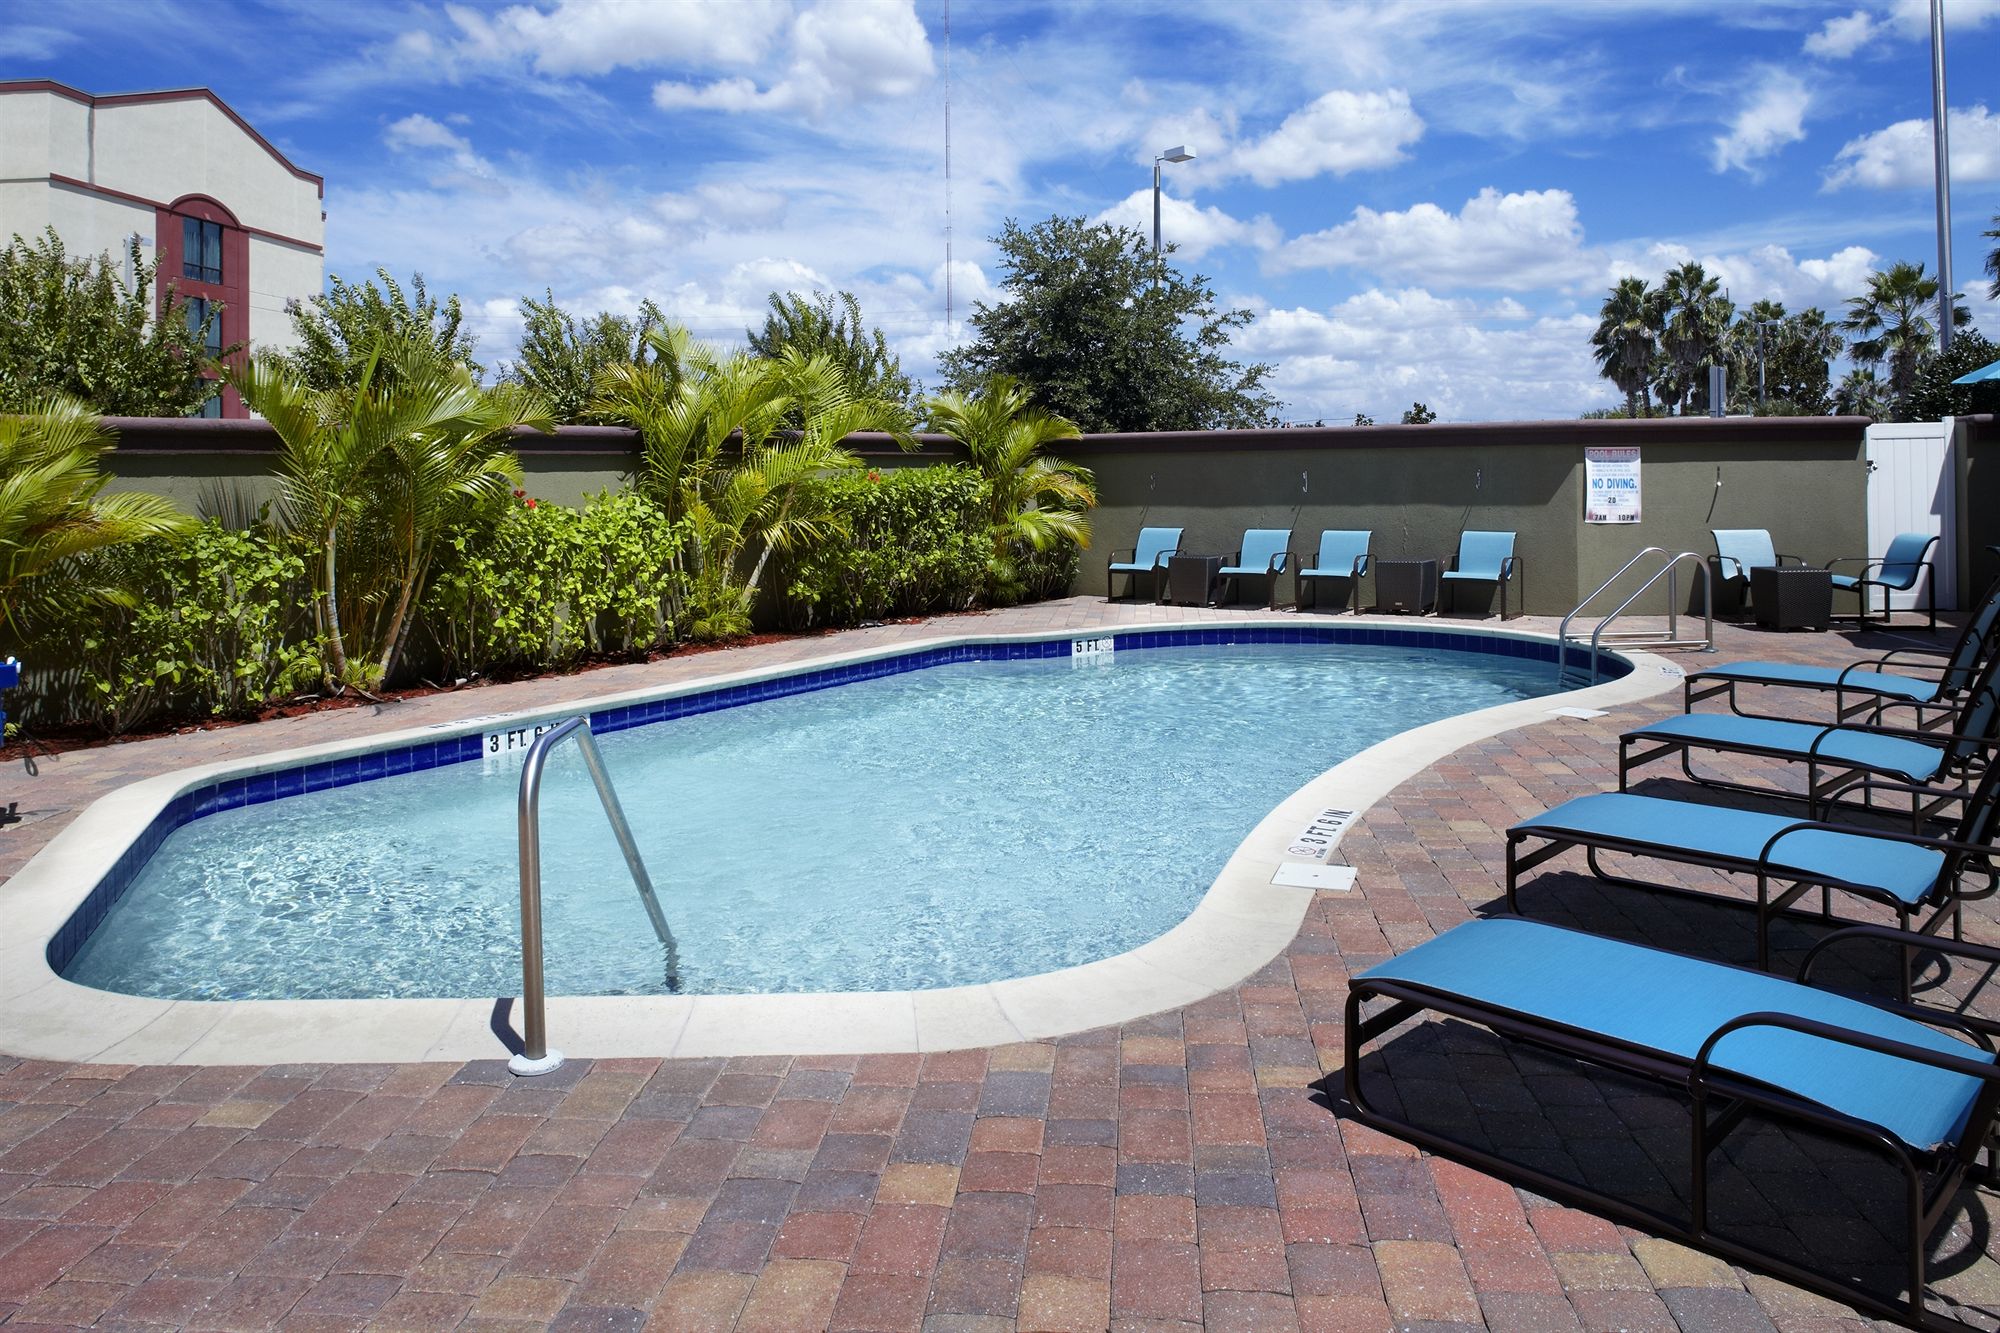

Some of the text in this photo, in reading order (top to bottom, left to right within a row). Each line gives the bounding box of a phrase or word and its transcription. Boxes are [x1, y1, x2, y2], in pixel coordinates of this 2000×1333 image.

[1592, 478, 1637, 489] NO DIVING.
[1076, 641, 1082, 653] 5
[490, 735, 499, 752] 3
[1300, 837, 1327, 845] 3
[1316, 818, 1342, 826] 6
